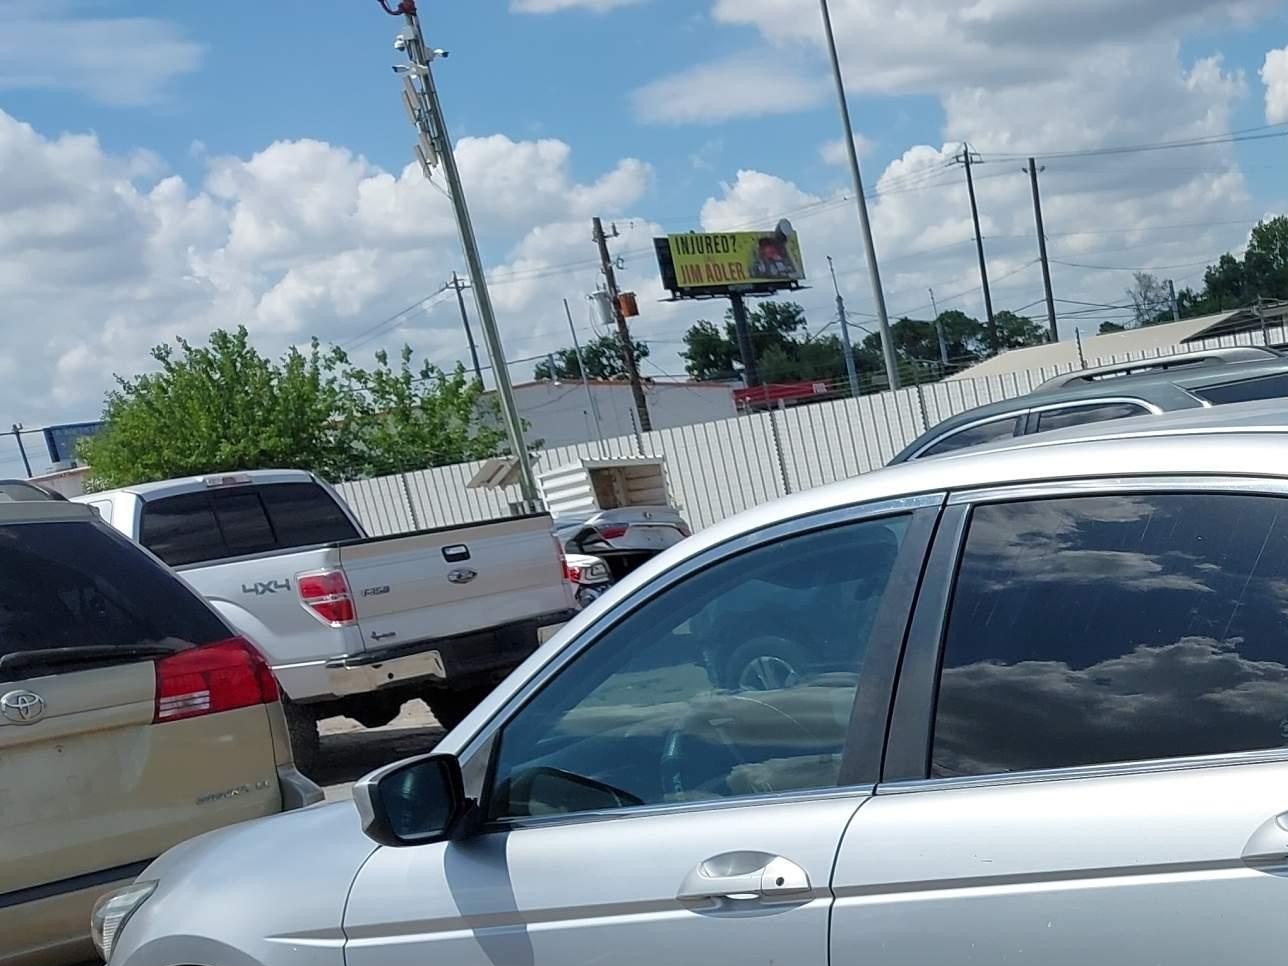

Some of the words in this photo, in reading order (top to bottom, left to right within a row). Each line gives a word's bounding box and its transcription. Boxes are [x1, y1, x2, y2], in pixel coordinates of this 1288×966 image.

[674, 234, 737, 255] INJURED?
[680, 264, 703, 284] JIM
[704, 262, 746, 282] ADLER
